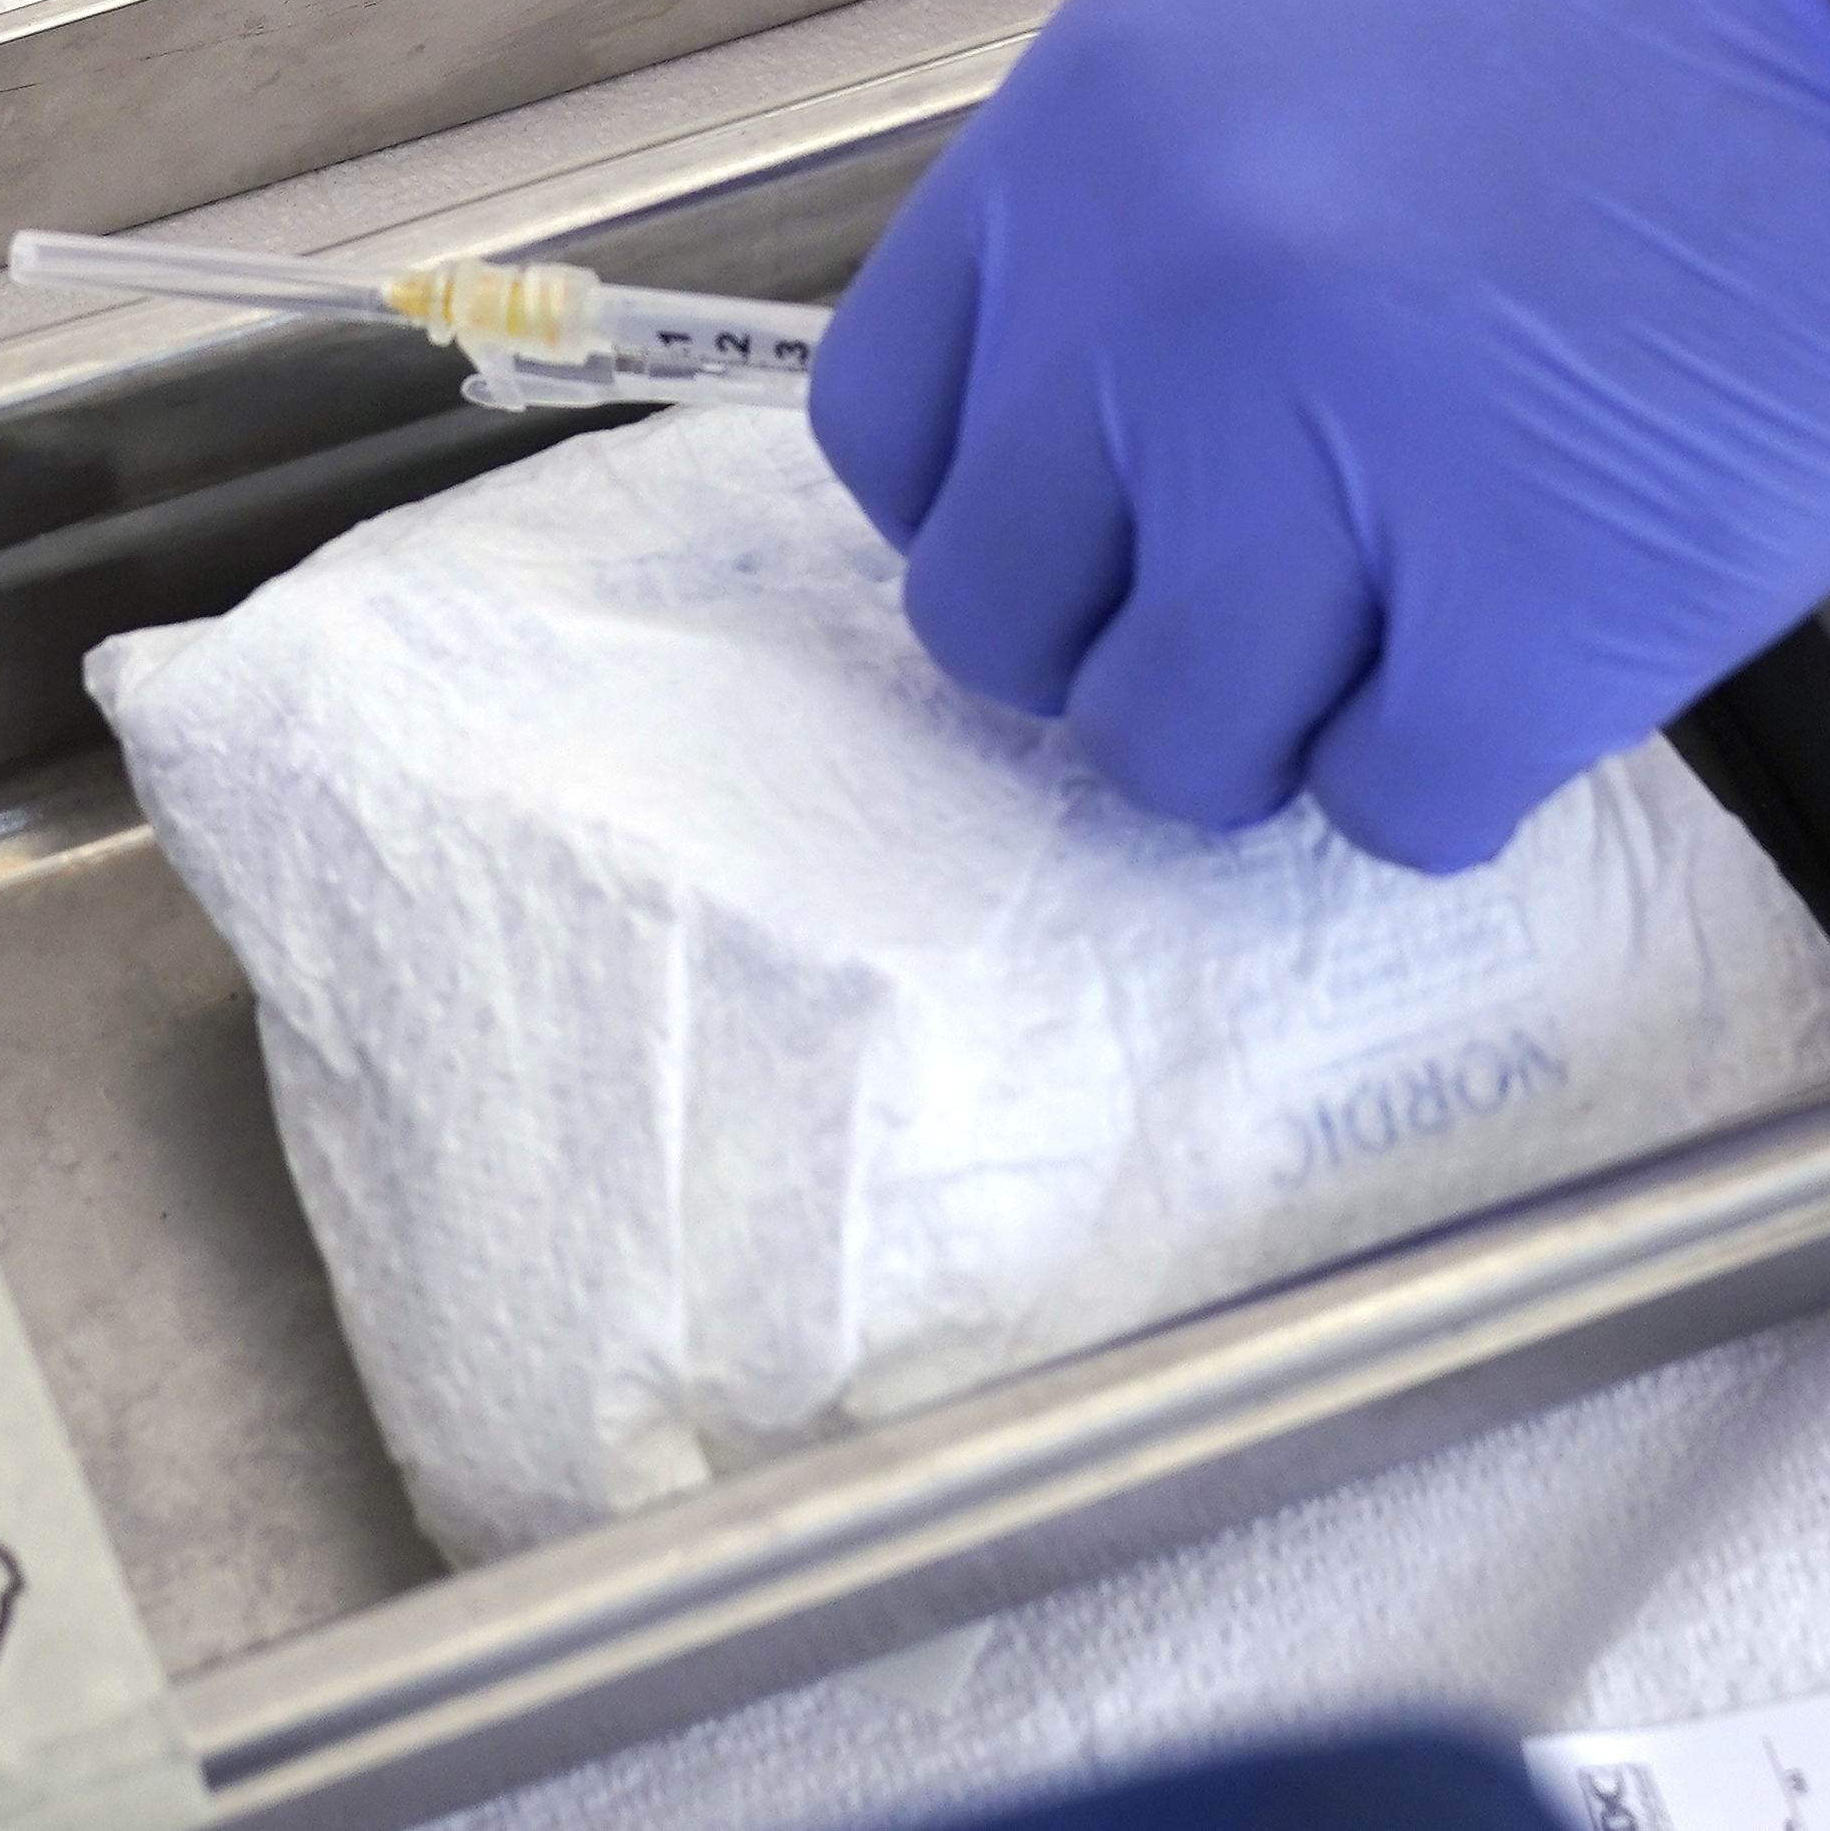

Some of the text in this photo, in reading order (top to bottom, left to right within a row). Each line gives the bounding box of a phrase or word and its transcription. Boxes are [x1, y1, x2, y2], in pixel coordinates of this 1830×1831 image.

[656, 330, 812, 366] 1 2 3
